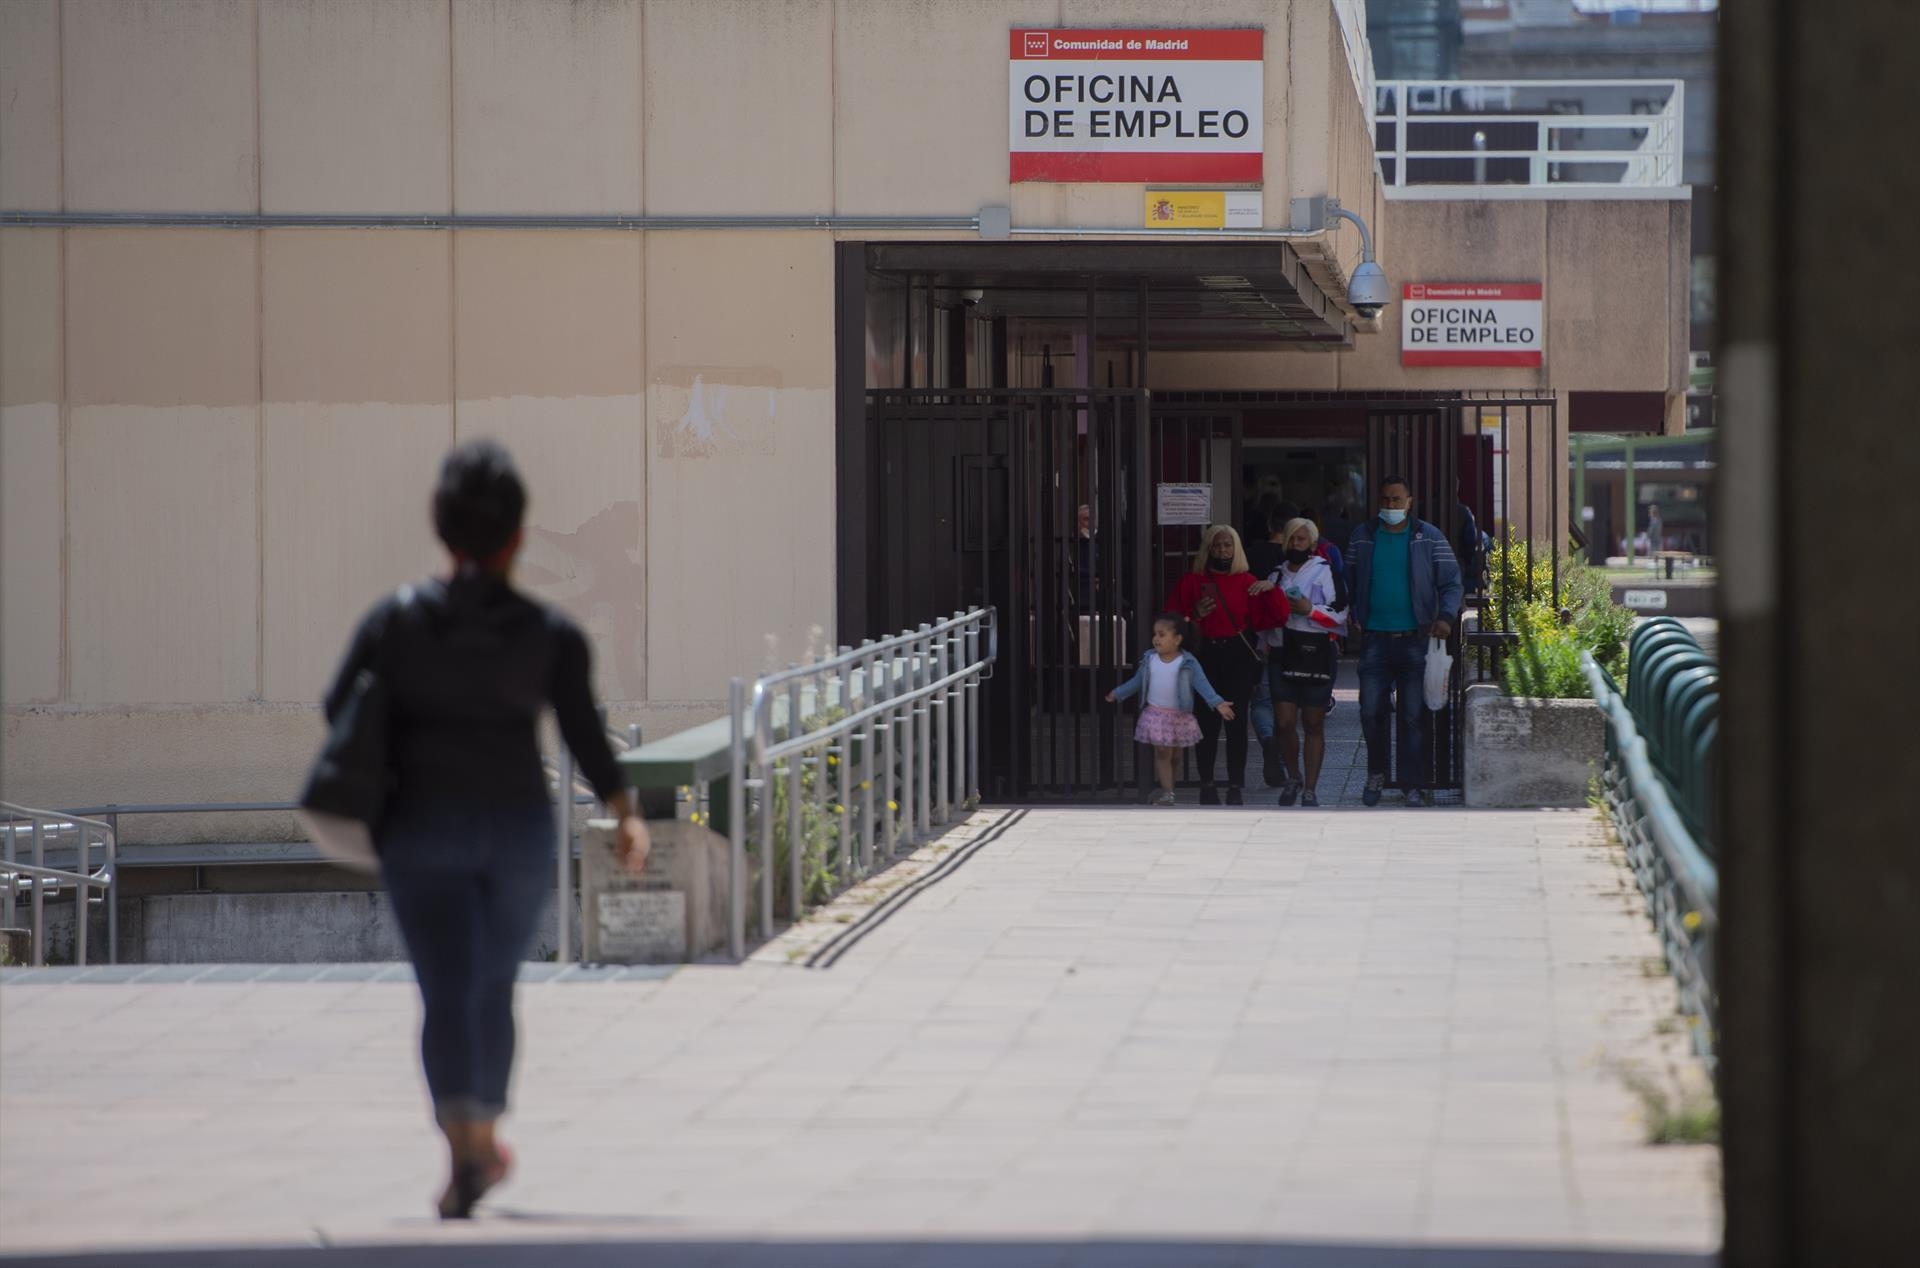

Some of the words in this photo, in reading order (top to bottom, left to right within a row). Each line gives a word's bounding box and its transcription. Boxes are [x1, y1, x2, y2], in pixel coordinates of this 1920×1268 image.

[1053, 39, 1124, 50] Comunidad
[1126, 39, 1142, 50] de
[1145, 39, 1189, 50] Madrid
[1023, 75, 1183, 104] OFICINA
[1024, 109, 1075, 138] DE
[1089, 109, 1249, 139] EMPLEO
[1426, 288, 1466, 296] Comunidad
[1477, 288, 1502, 296] Madrid
[1410, 308, 1498, 325] OFICINA
[1410, 327, 1439, 343] DE
[1446, 327, 1535, 344] EMPLEO
